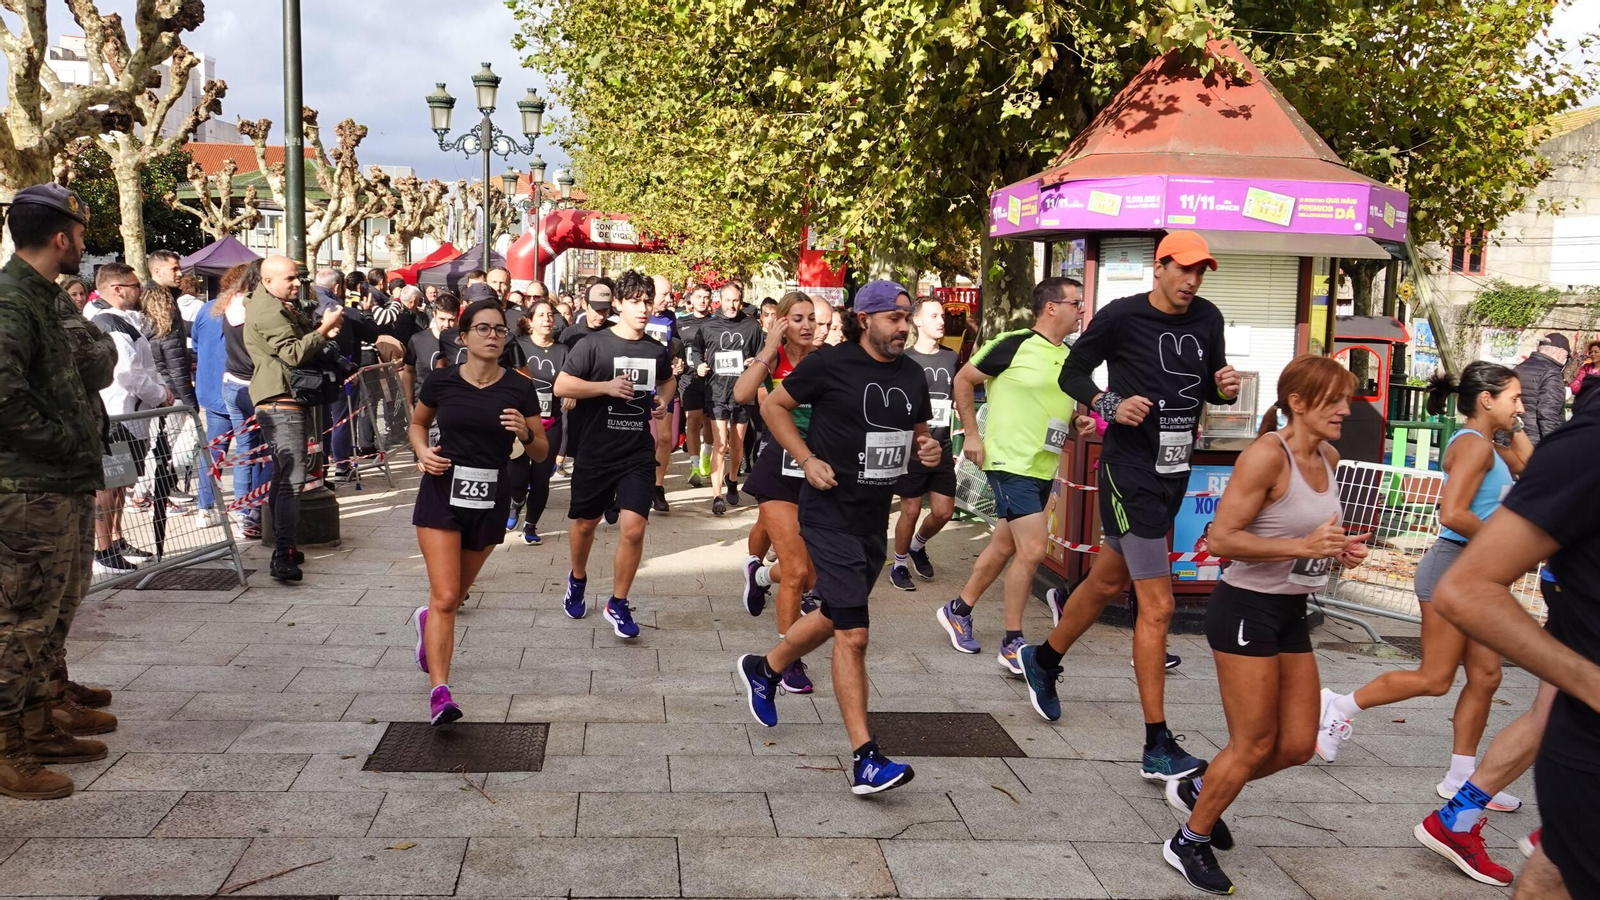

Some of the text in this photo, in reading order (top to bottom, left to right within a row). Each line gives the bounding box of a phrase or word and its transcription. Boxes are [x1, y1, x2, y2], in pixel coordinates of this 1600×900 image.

[1180, 193, 1215, 212] 11/11
[1298, 204, 1334, 212] PREMIOS
[1335, 206, 1356, 220] DÁ
[598, 231, 609, 239] DE
[720, 358, 734, 368] 165
[616, 420, 644, 428] MÓVOME
[1160, 416, 1170, 425] EU
[1050, 430, 1067, 446] 652
[876, 446, 902, 466] 774
[1164, 445, 1187, 462] 524
[460, 480, 489, 498] 263
